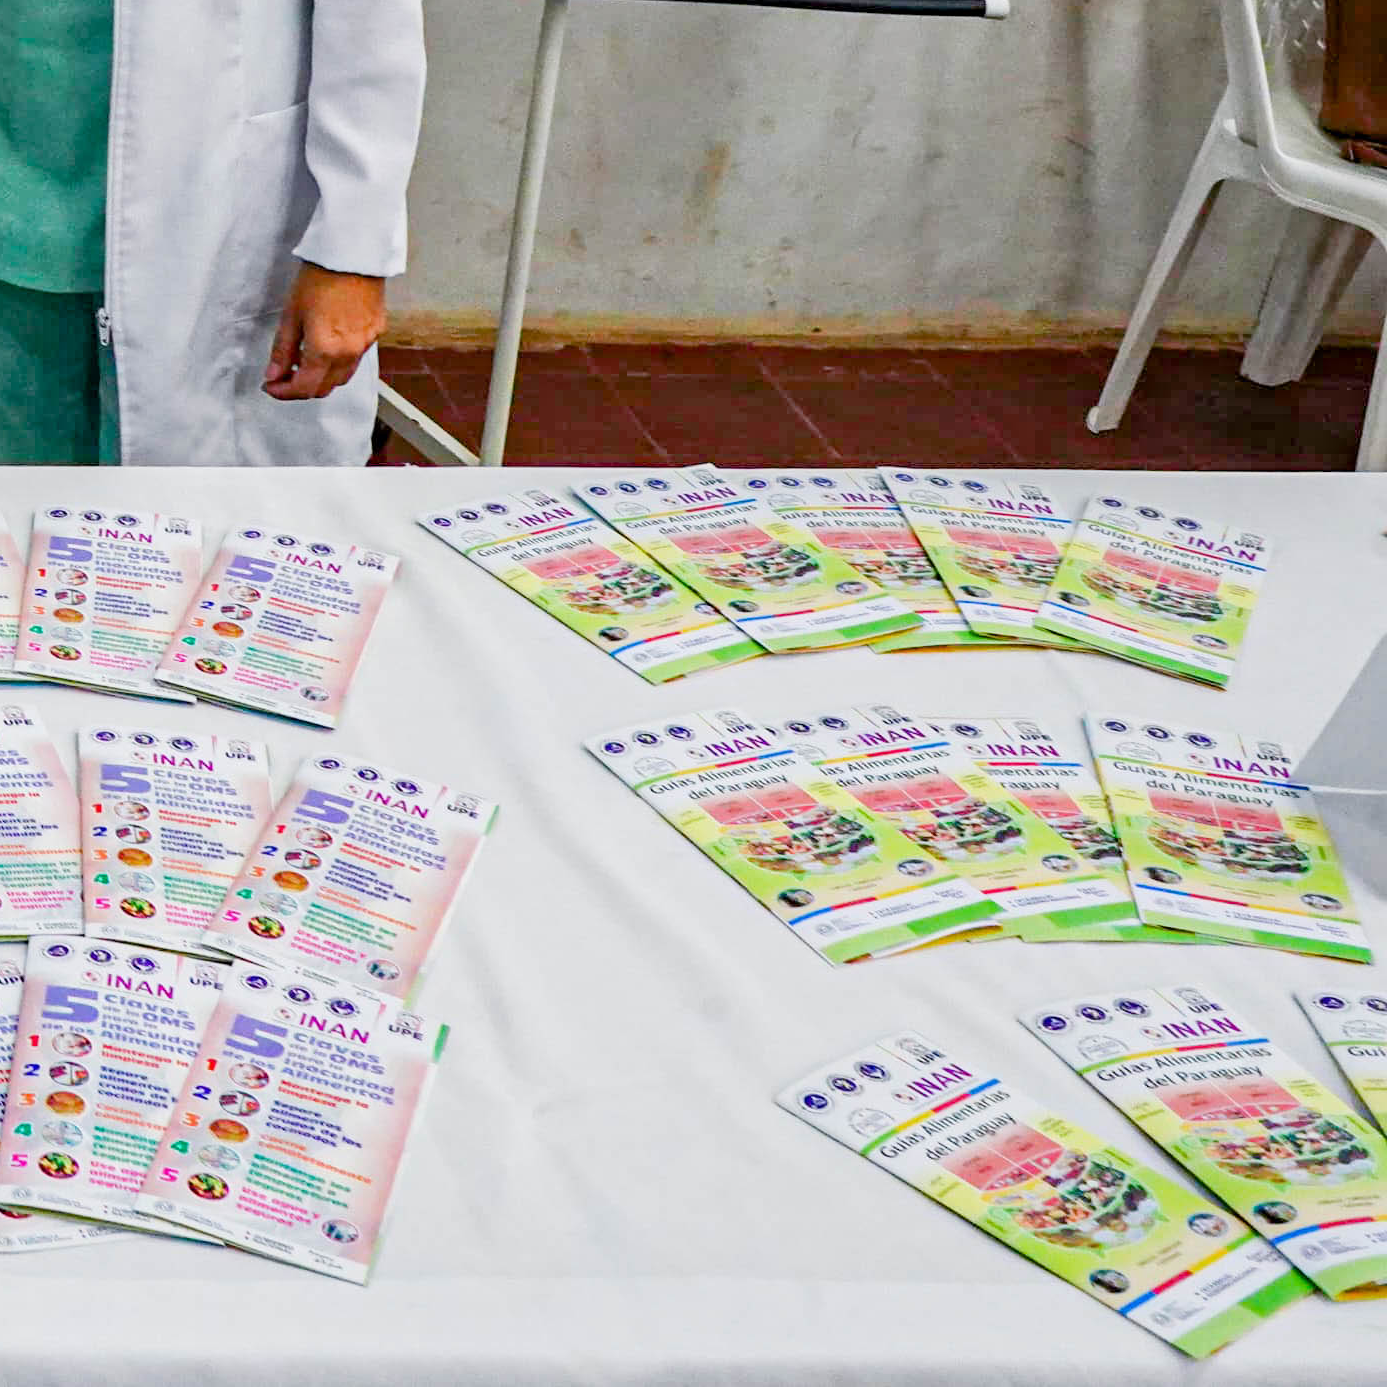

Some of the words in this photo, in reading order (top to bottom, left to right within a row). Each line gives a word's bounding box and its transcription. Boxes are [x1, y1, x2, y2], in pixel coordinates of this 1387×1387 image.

[677, 486, 738, 505] INAN
[988, 497, 1055, 515] INAN
[518, 506, 573, 528] INAN
[98, 528, 154, 545] INAN
[164, 527, 193, 536] UPE
[1186, 535, 1258, 563] INAN
[285, 552, 344, 575] INAN
[356, 561, 387, 572] UPE
[3, 718, 35, 726] UPE
[704, 734, 771, 759] INAN
[856, 726, 926, 748] INAN
[224, 750, 256, 762] UPE
[987, 744, 1061, 758] INAN
[1257, 753, 1292, 764] UPE
[151, 752, 215, 773] INAN
[698, 756, 797, 786] Alimentarias
[865, 763, 940, 784] Paraguay
[1213, 757, 1290, 779] INAN
[717, 772, 788, 797] Paraguay
[1146, 779, 1176, 792] del
[1184, 786, 1275, 808] Paraguay
[1174, 772, 1301, 799] Alimentarias
[365, 788, 430, 820] INAN
[446, 804, 480, 819] UPE
[106, 973, 175, 1000] INAN
[189, 977, 225, 991] UPE
[41, 984, 100, 1024] 5
[1188, 1003, 1225, 1014] UPE
[225, 1013, 288, 1059] 5
[299, 1013, 370, 1044] INAN
[388, 1024, 424, 1041] UPE
[1161, 1016, 1242, 1039] INAN
[1154, 1046, 1273, 1069] Alimentarias
[906, 1063, 973, 1098] INAN
[1143, 1071, 1178, 1090] del
[1177, 1065, 1264, 1083] Paraguay
[921, 1090, 1011, 1137] Alimentarias
[925, 1141, 955, 1161] del
[947, 1113, 1017, 1148] Paraguay
